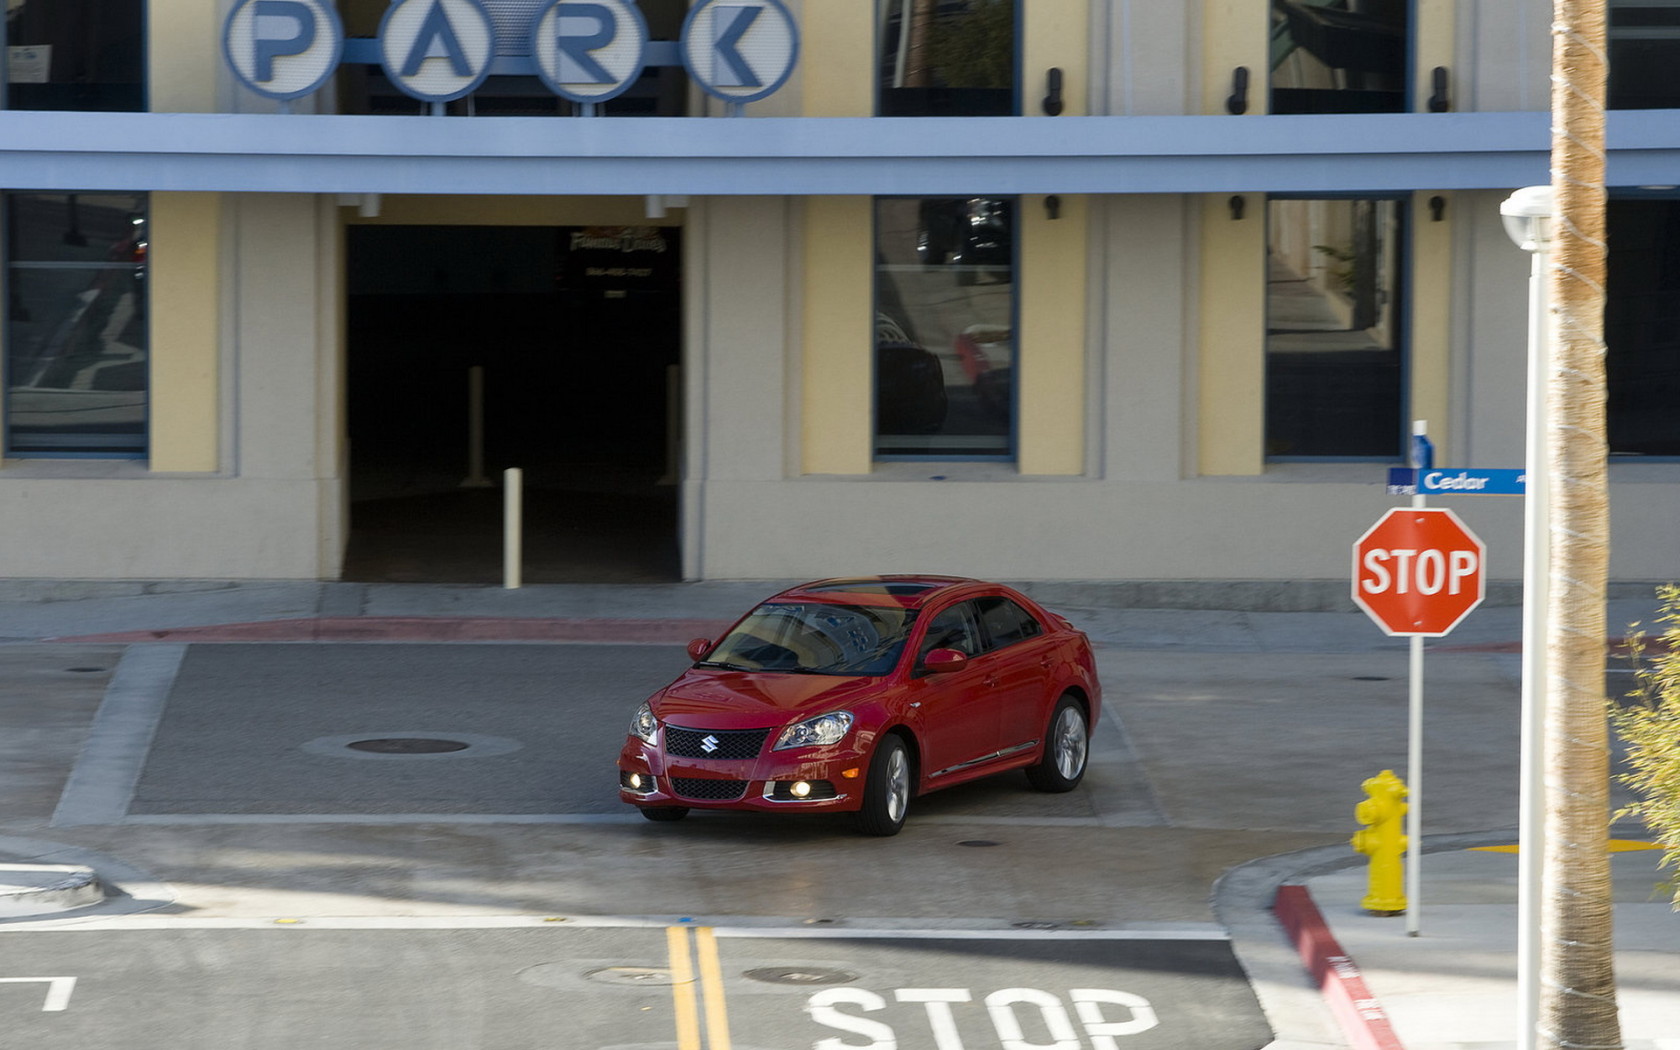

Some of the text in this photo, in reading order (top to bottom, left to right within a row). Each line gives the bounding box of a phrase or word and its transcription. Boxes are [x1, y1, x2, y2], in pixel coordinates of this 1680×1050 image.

[253, 0, 764, 88] PARK
[1424, 471, 1489, 490] Cedar
[1362, 548, 1478, 596] STOP
[804, 987, 1159, 1050] STOP
